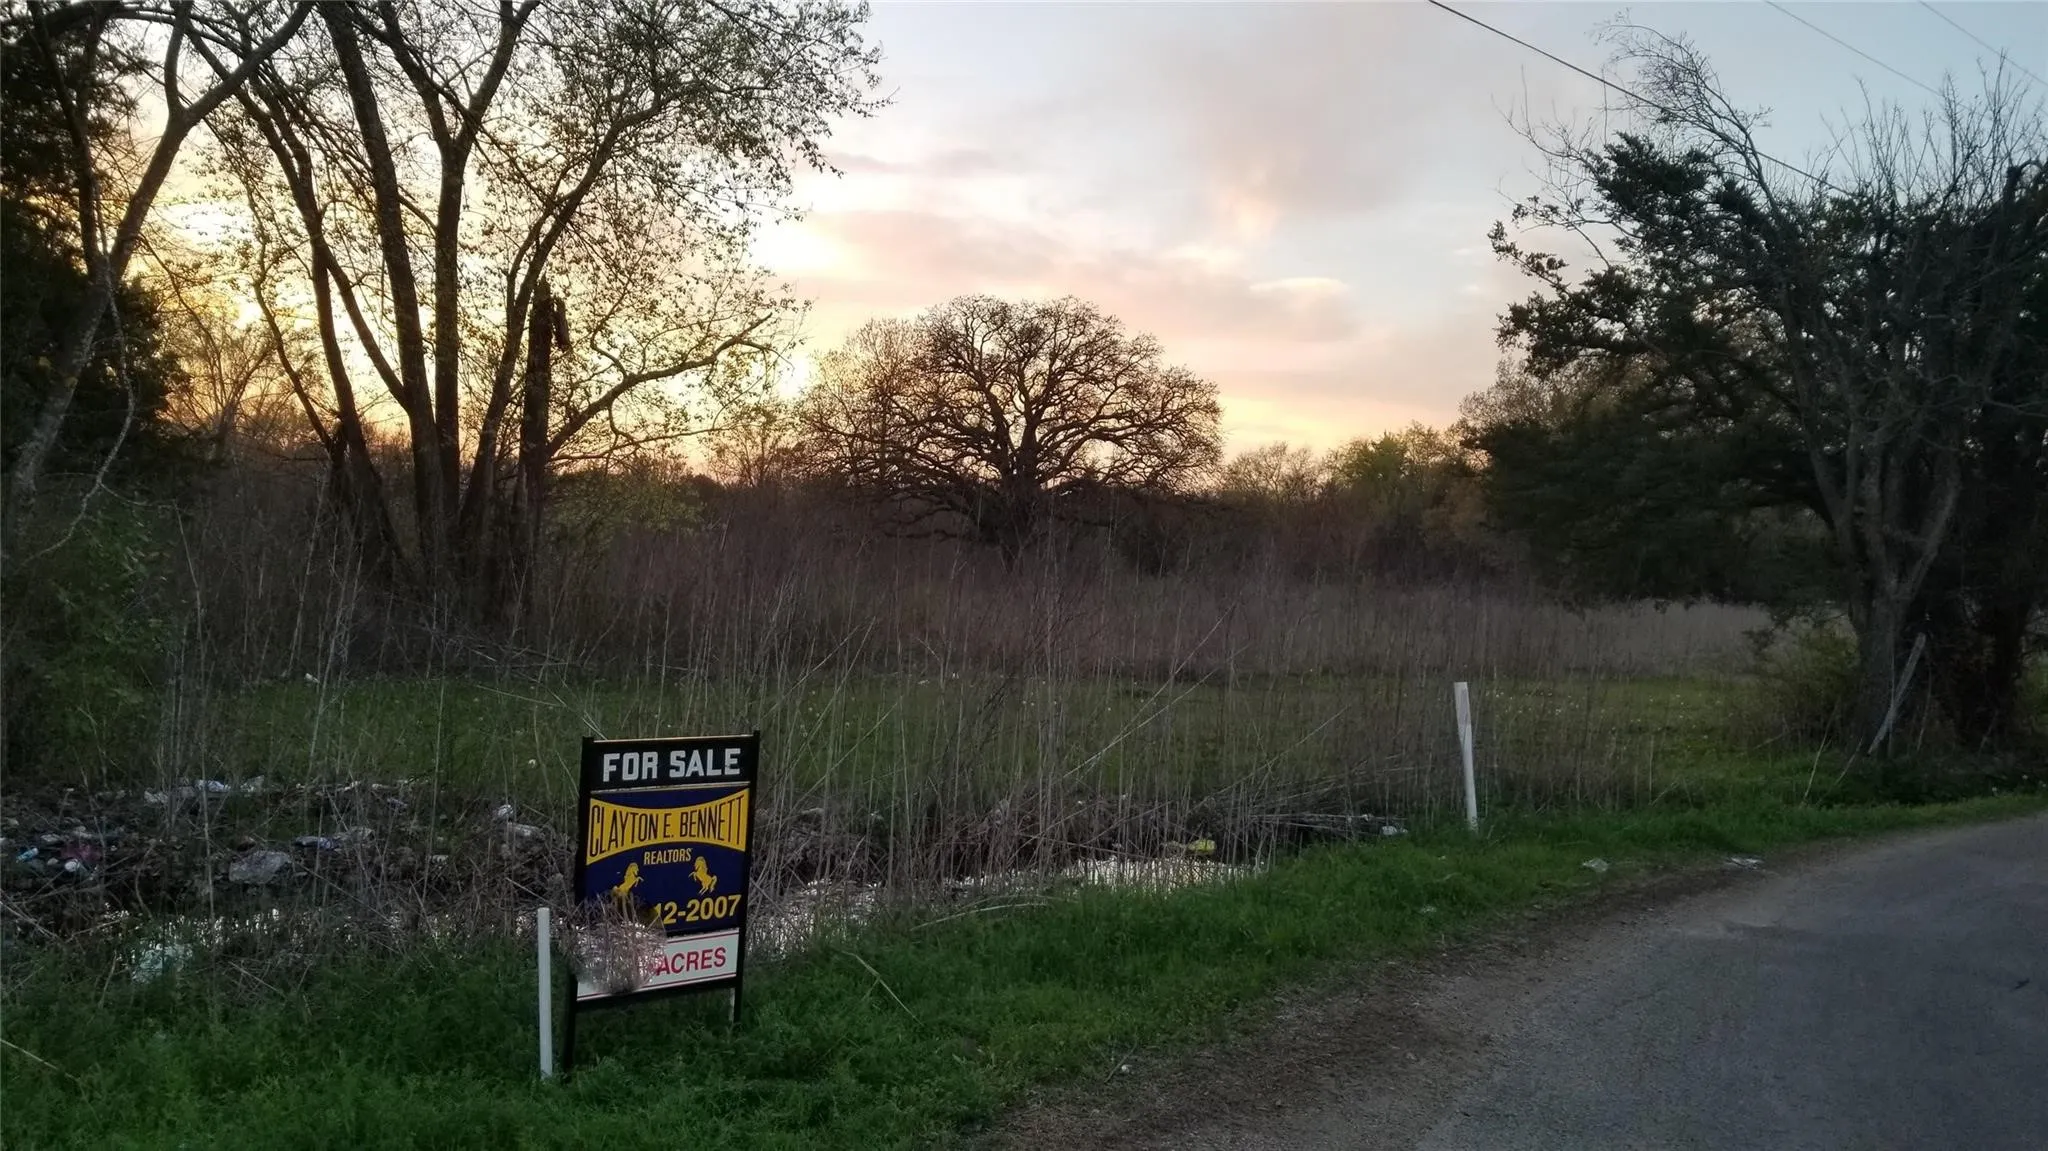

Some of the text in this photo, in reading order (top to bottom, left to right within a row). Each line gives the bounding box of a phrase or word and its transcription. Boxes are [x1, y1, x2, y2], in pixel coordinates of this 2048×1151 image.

[603, 748, 741, 782] FOR SALE
[589, 795, 745, 857] CLAYTON E. BENNETT
[643, 848, 693, 865] REALTORS
[655, 947, 727, 976] ACRES
